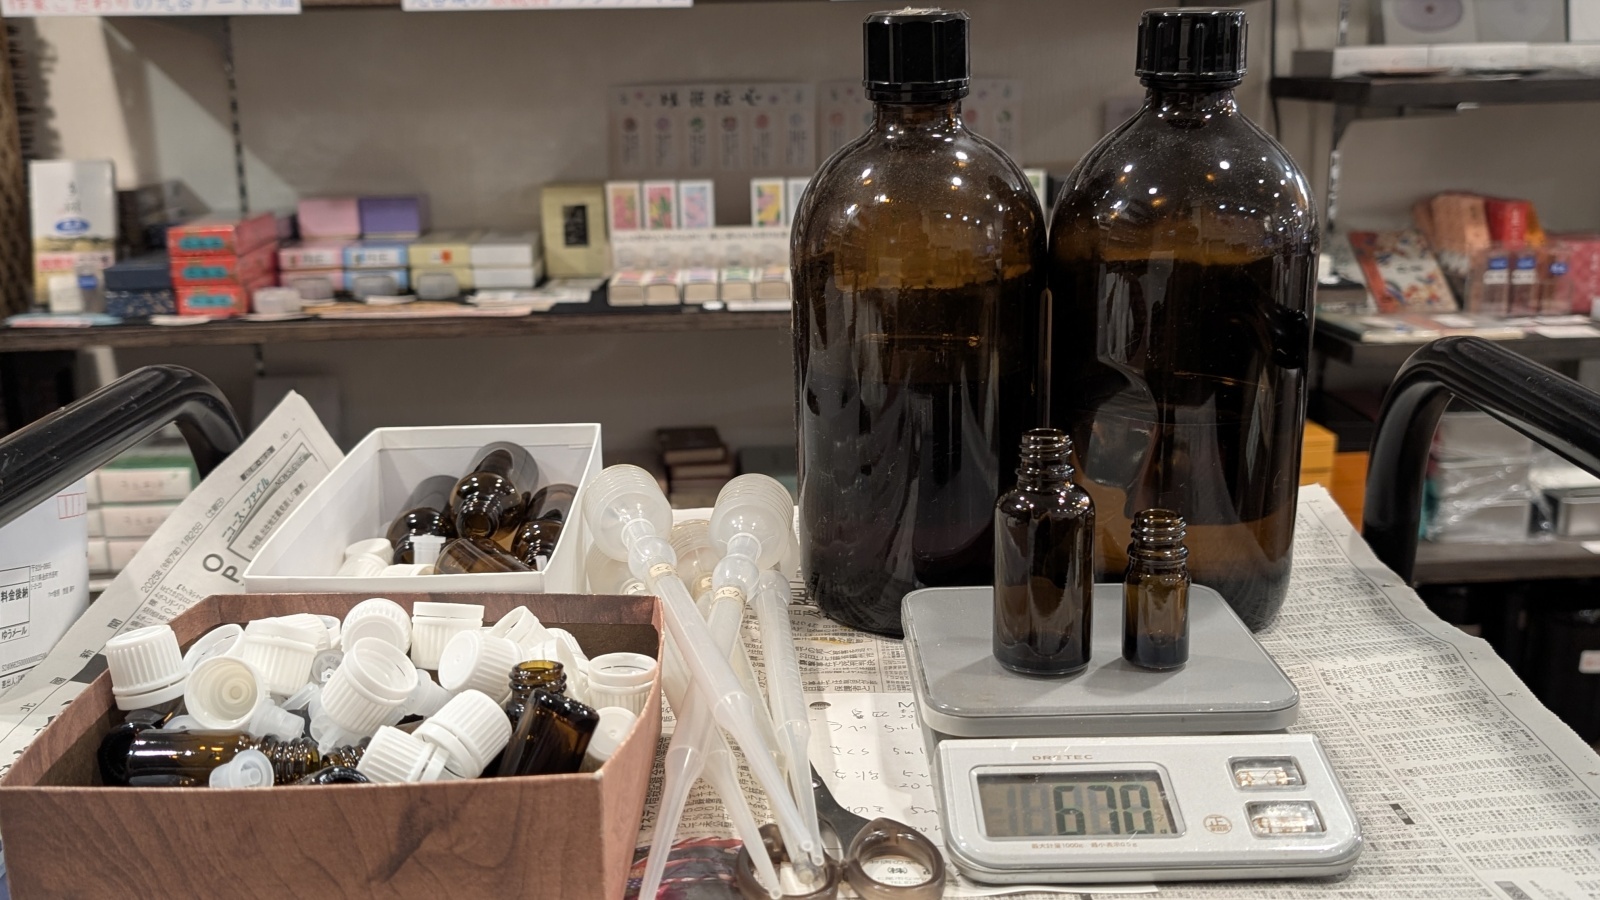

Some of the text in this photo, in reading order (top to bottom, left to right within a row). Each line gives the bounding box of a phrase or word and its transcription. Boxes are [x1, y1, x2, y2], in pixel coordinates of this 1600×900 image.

[222, 476, 270, 542] ニュース・ファイル
[0, 586, 28, 603] 料金後納
[1, 626, 28, 640] ゆうメール
[1210, 815, 1224, 826] 正
